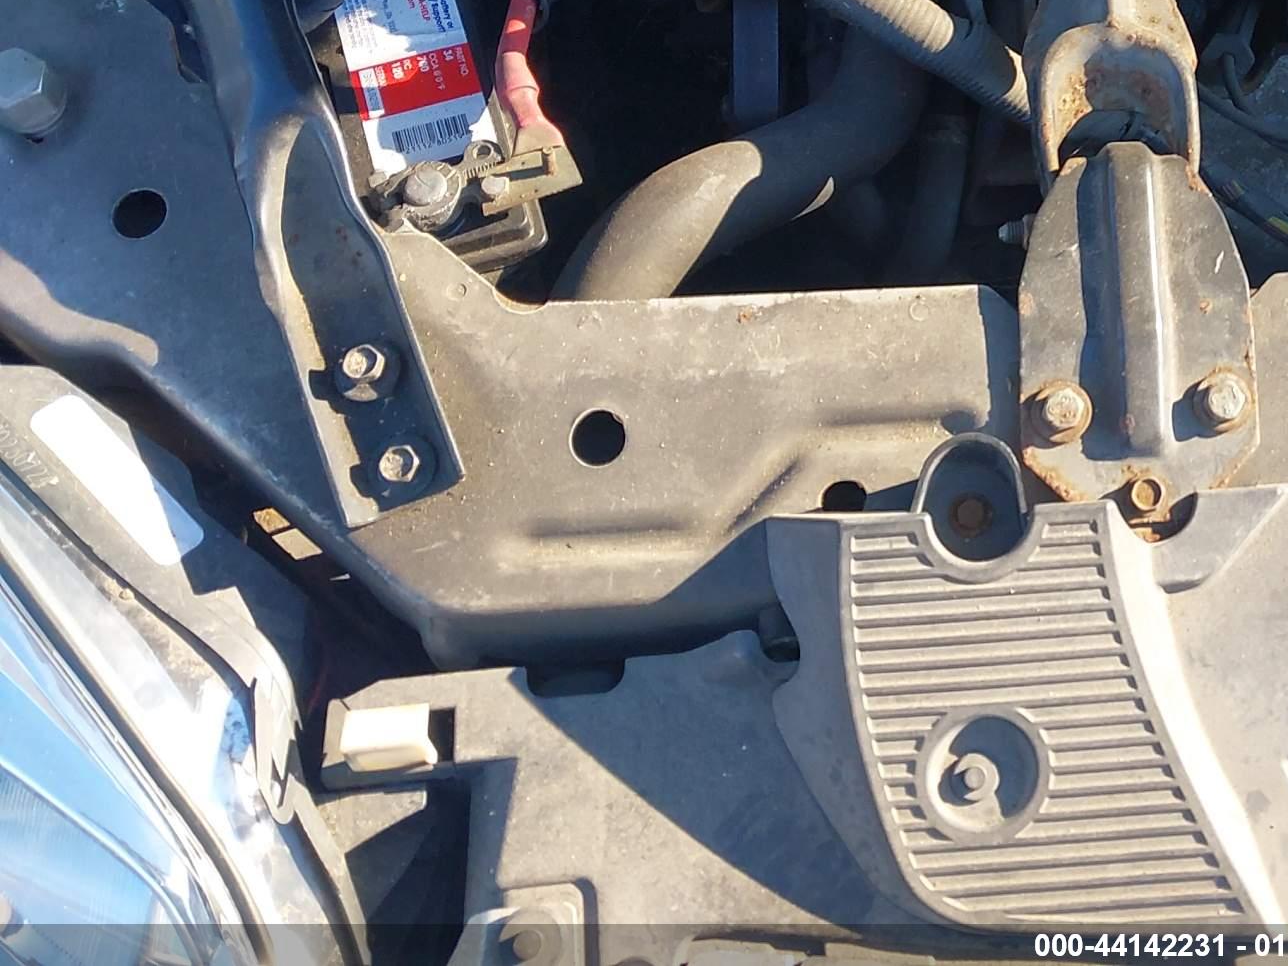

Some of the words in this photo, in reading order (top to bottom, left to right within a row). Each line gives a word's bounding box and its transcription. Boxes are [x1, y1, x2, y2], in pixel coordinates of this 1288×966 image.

[428, 53, 438, 68] CCA
[443, 49, 453, 60] 34
[455, 46, 464, 62] PART
